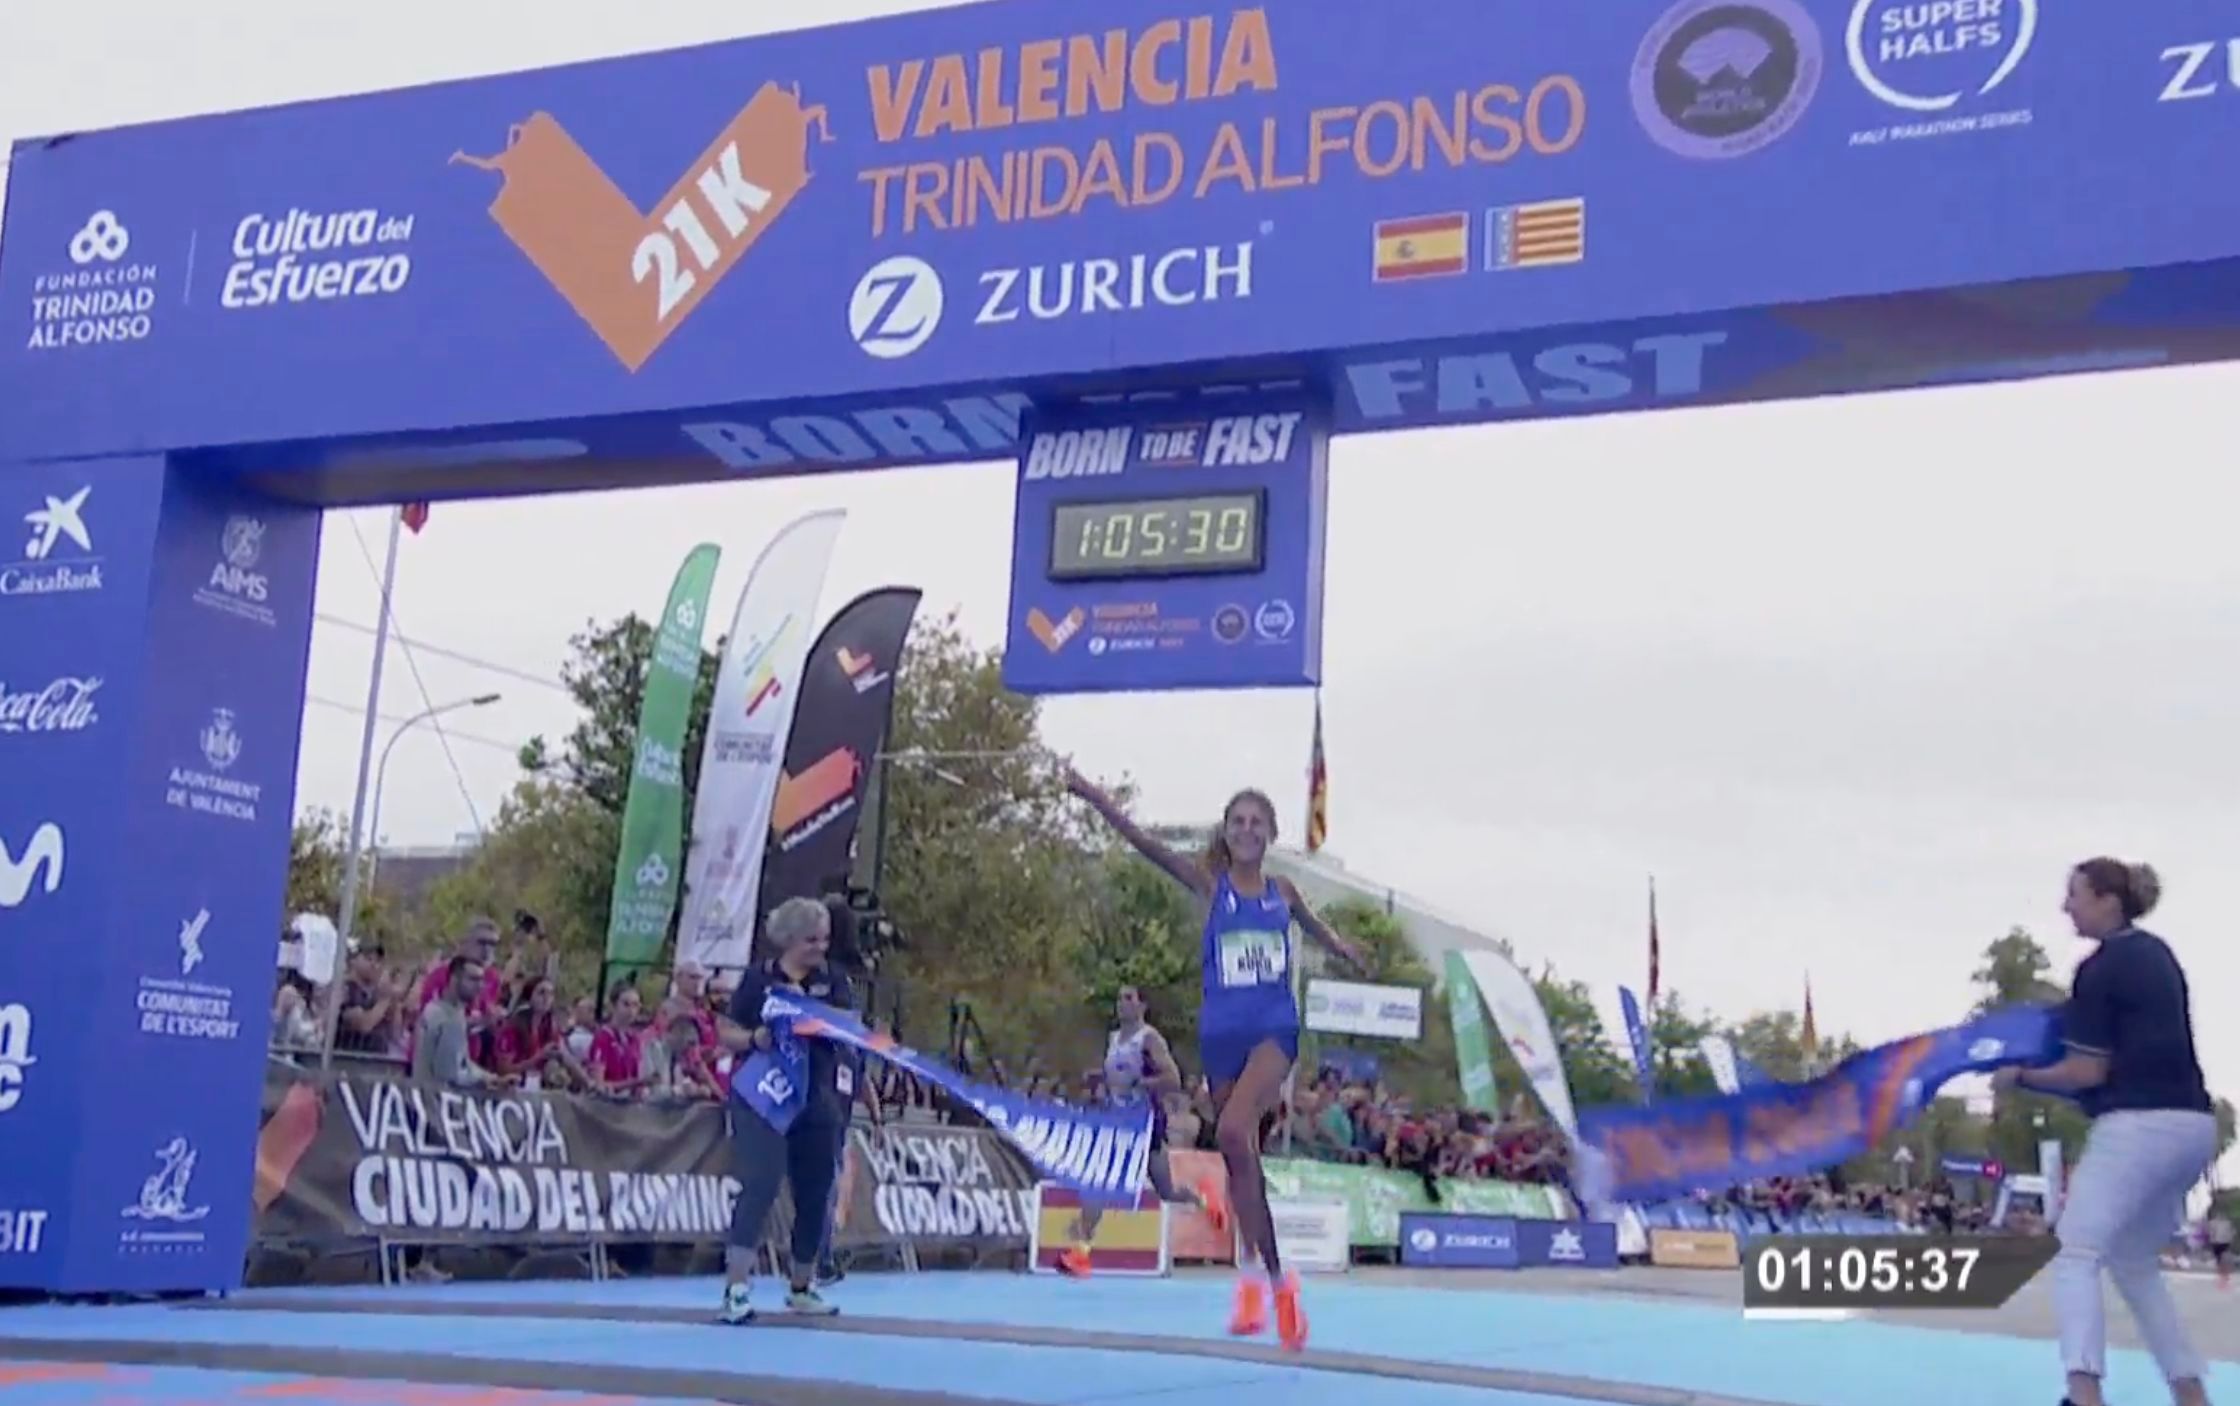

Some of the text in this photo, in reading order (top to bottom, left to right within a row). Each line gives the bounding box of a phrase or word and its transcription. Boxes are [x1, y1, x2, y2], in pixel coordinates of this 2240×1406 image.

[1880, 22, 2001, 62] HALFS
[1881, 0, 2001, 33] SUPER
[867, 6, 1278, 142] VALENCIA
[857, 133, 1183, 238] TRINIDAD
[1194, 74, 1586, 199] ALFONSO
[232, 206, 415, 260] Cultura del
[631, 140, 773, 322] 21K
[32, 287, 155, 321] TRINIDAD
[220, 253, 410, 309] Esfuerzo
[974, 241, 1254, 325] ZURICH
[27, 315, 151, 350] ALFONSO
[1346, 331, 1728, 418] FAST
[680, 391, 1033, 468] BORN
[1024, 426, 1133, 480] BORN
[1202, 412, 1302, 467] FAST
[1079, 507, 1247, 559] 1:05:30
[0, 565, 103, 595] CaixaBank
[210, 562, 269, 602] AIMS
[166, 787, 187, 808] DE
[169, 766, 261, 802] AJUNTAMENT
[137, 989, 231, 1019] COMUNITAT
[141, 1012, 165, 1034] DE
[339, 1081, 568, 1165] VALENCIA
[855, 1128, 994, 1186] VALENCIA
[352, 1155, 532, 1232] CIUDAD
[532, 1168, 605, 1232] DEL
[874, 1184, 978, 1236] CIUDAD
[972, 1187, 1024, 1236] DEL
